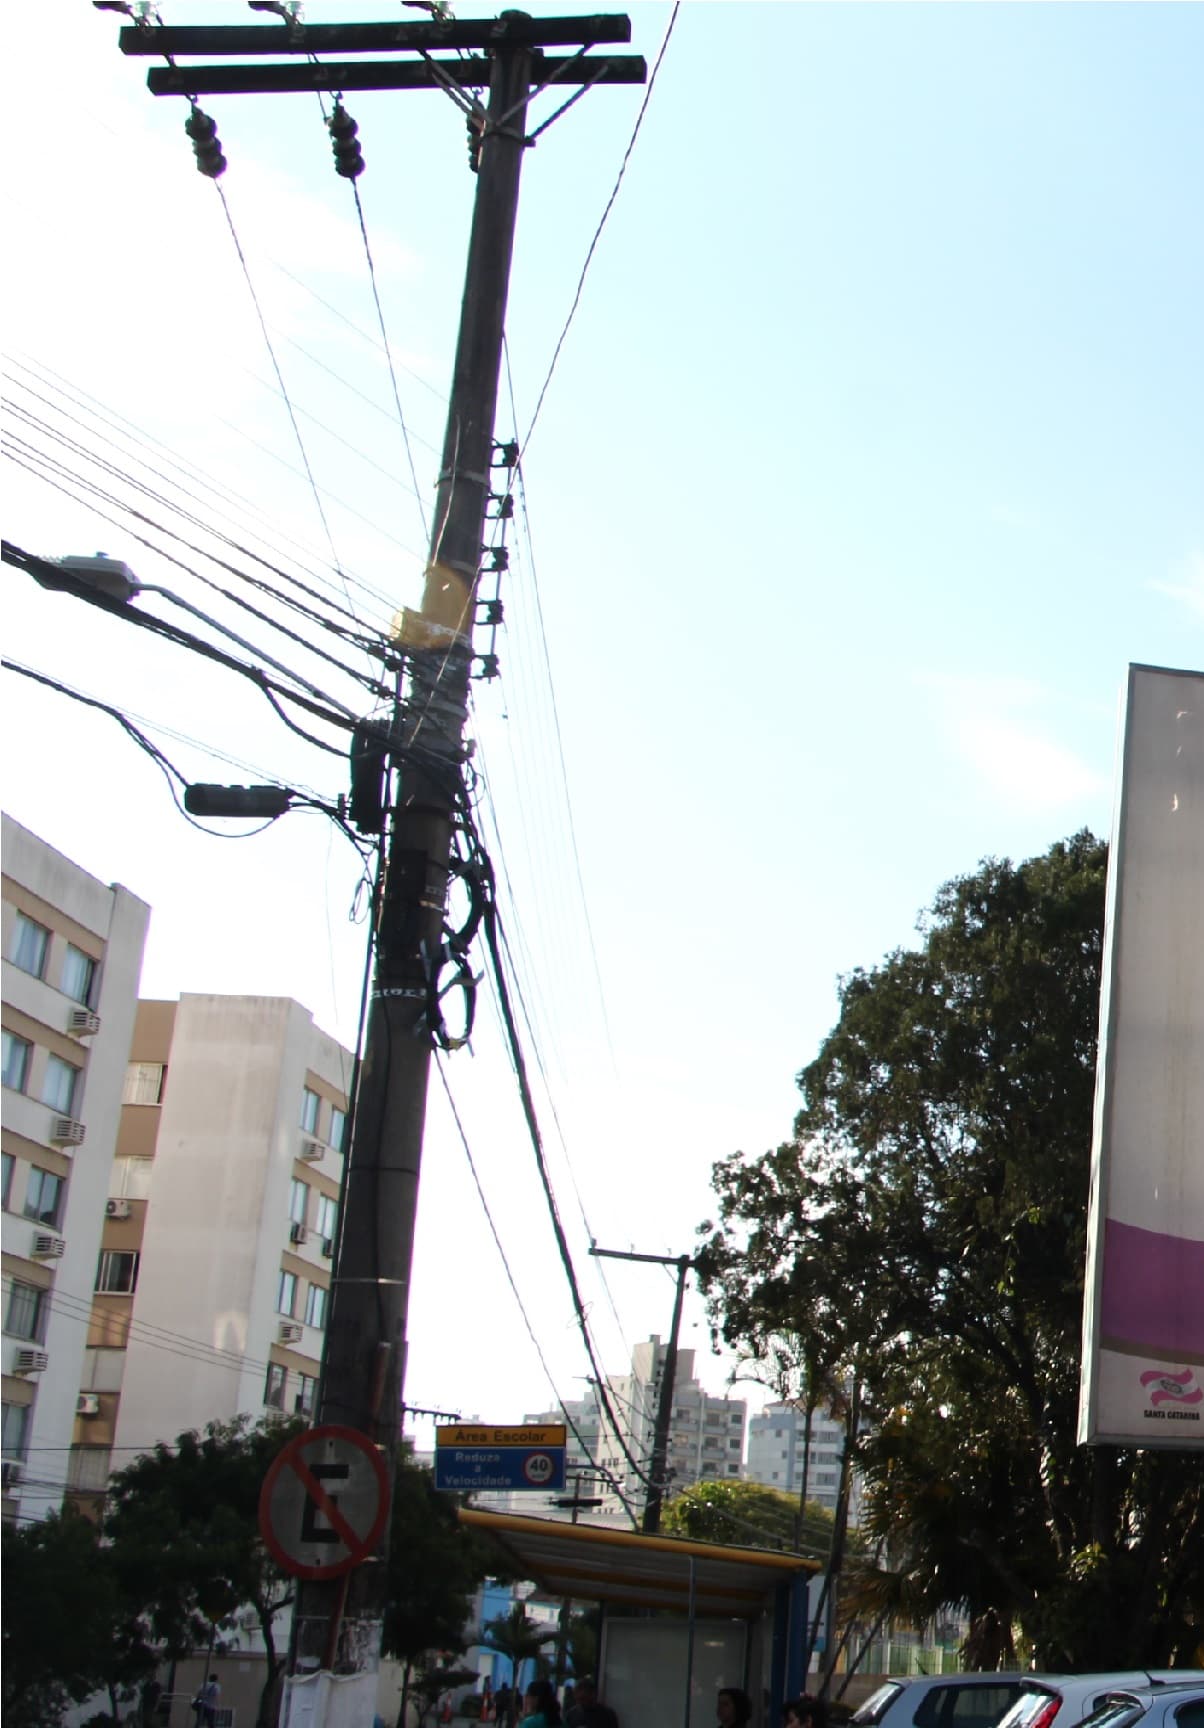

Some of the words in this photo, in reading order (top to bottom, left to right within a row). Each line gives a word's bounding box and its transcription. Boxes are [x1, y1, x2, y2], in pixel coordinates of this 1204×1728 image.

[1144, 1409, 1166, 1420] SANTA
[455, 1429, 488, 1442] Área
[494, 1430, 546, 1442] Escolar
[530, 1458, 548, 1472] 40
[444, 1474, 512, 1486] Velocidade
[301, 1464, 349, 1543] E
